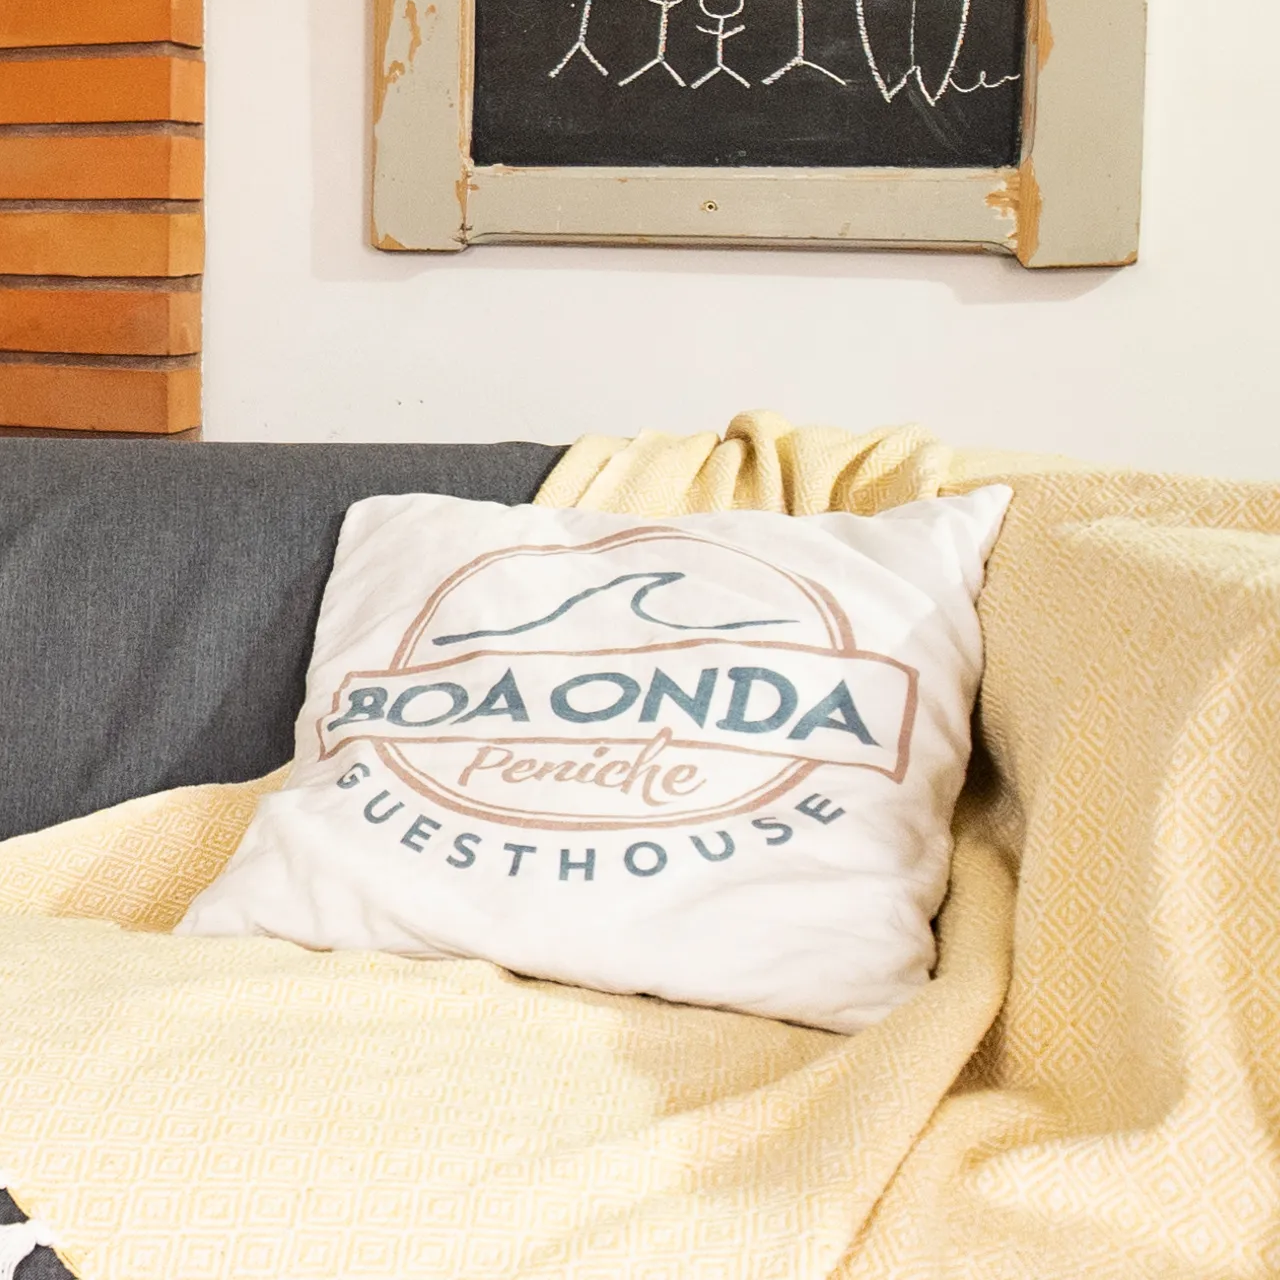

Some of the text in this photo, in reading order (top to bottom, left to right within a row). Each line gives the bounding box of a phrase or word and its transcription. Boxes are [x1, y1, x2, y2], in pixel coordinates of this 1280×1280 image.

[327, 665, 883, 746] BOA ONDA
[456, 726, 706, 807] Peniche
[336, 762, 848, 883] GUESTHOUSE
